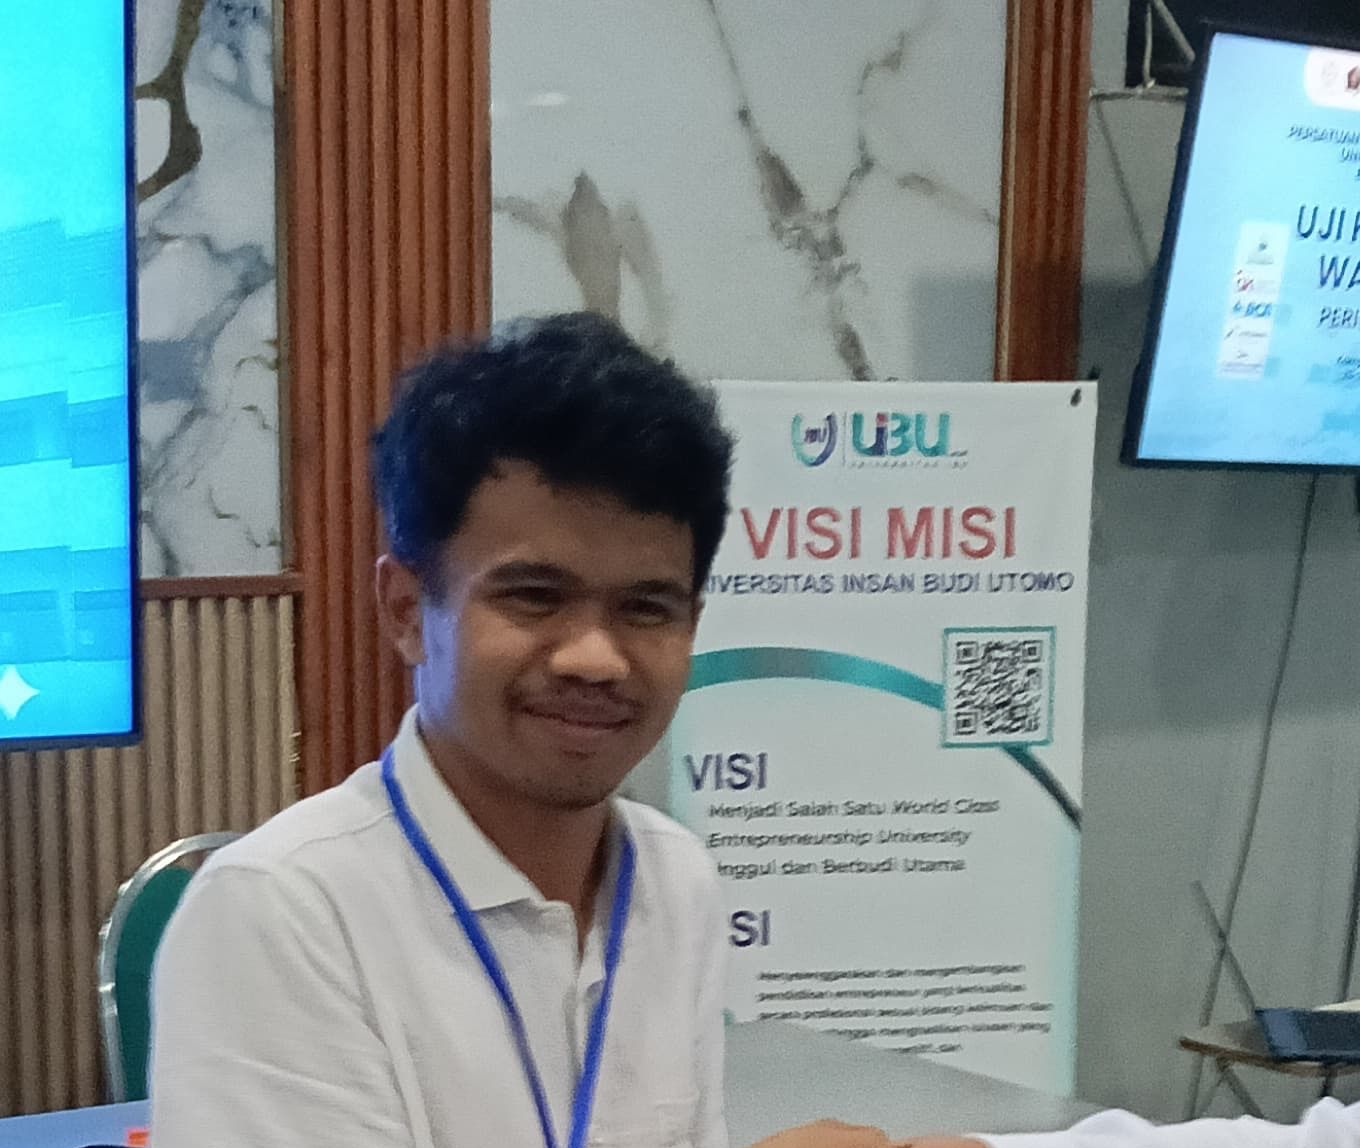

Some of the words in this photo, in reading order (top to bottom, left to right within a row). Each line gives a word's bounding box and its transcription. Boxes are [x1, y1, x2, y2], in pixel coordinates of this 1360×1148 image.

[1296, 204, 1346, 241] UJI
[740, 505, 861, 560] VISI
[886, 505, 1018, 560] MISI
[705, 573, 835, 595] IVERSITAS
[841, 572, 916, 593] INSAN
[922, 571, 980, 593] BUDI
[987, 570, 1076, 593] UTOMO
[683, 752, 769, 792] VISI
[717, 858, 777, 879] nggul
[728, 910, 772, 948] SI
